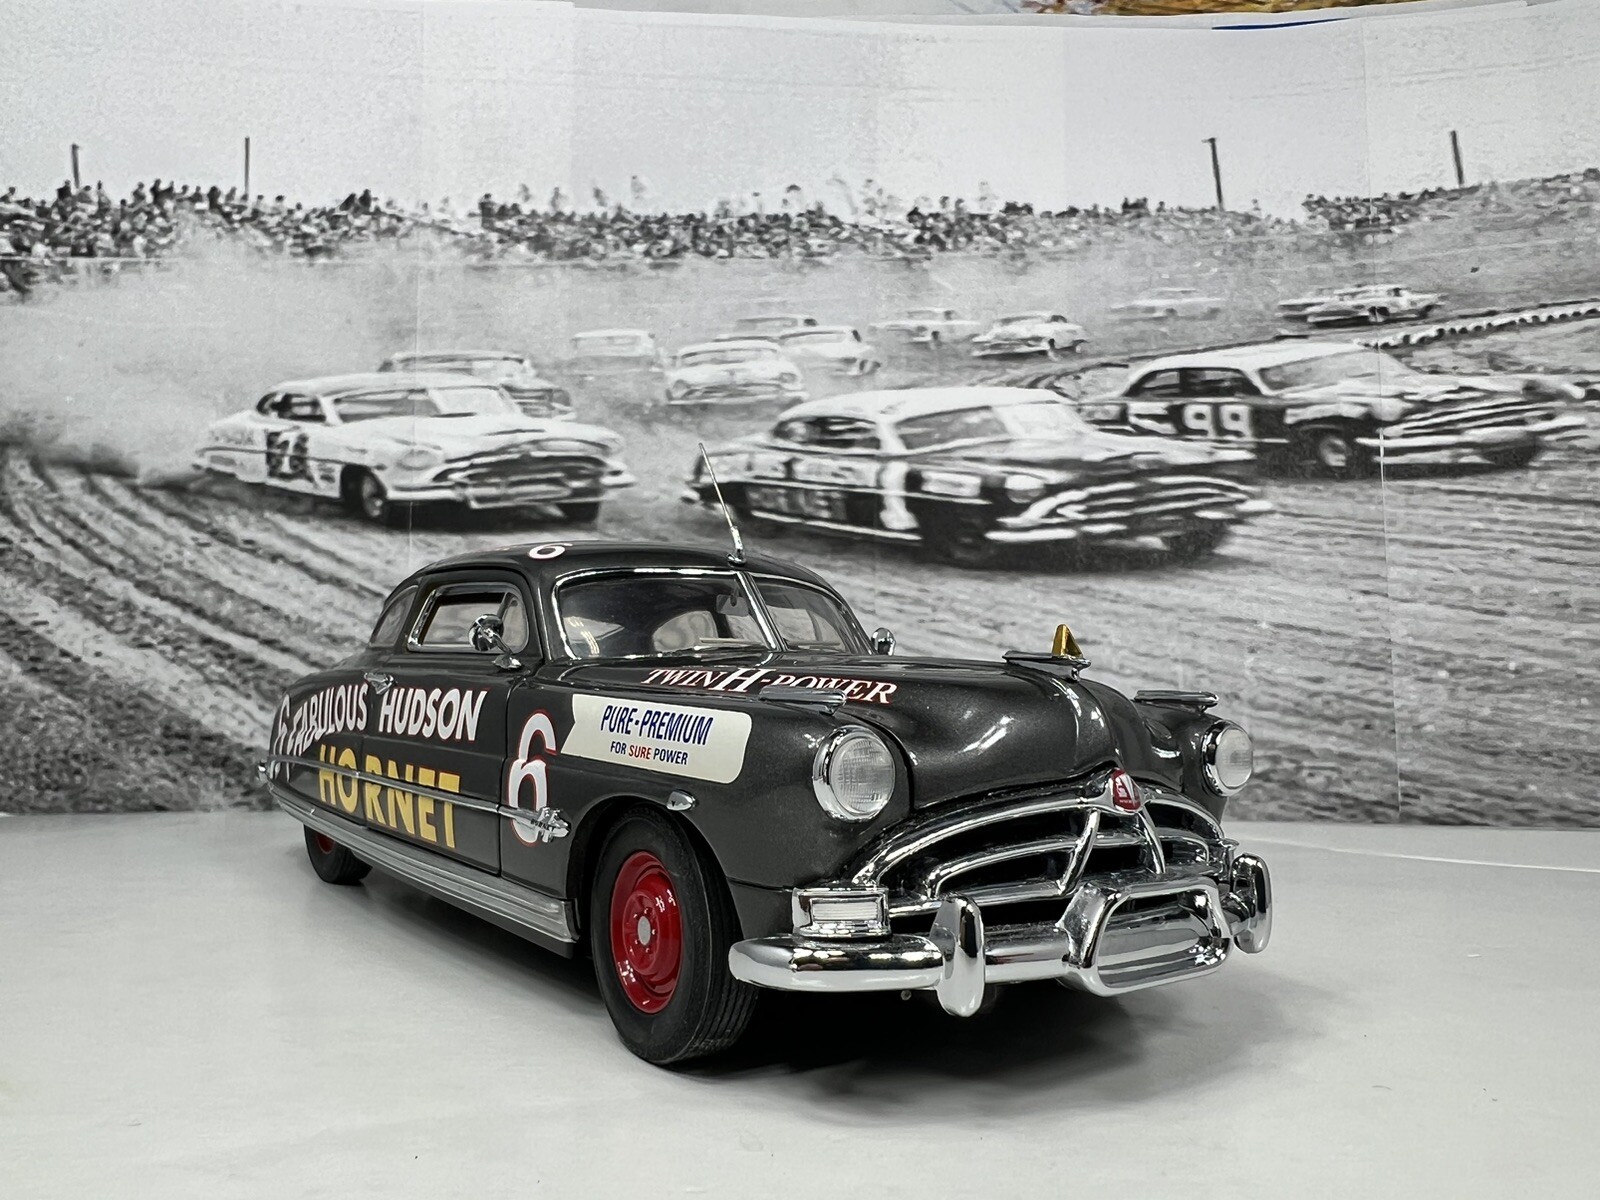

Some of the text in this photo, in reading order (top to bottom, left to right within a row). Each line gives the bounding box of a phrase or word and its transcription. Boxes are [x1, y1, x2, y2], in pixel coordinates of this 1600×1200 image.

[1184, 404, 1252, 439] 99
[528, 543, 573, 560] 6
[286, 683, 488, 781] FABULOUS HUDSON
[610, 740, 689, 765] FOR SURE POWER
[318, 743, 461, 849] HORNET
[508, 712, 557, 843] 6
